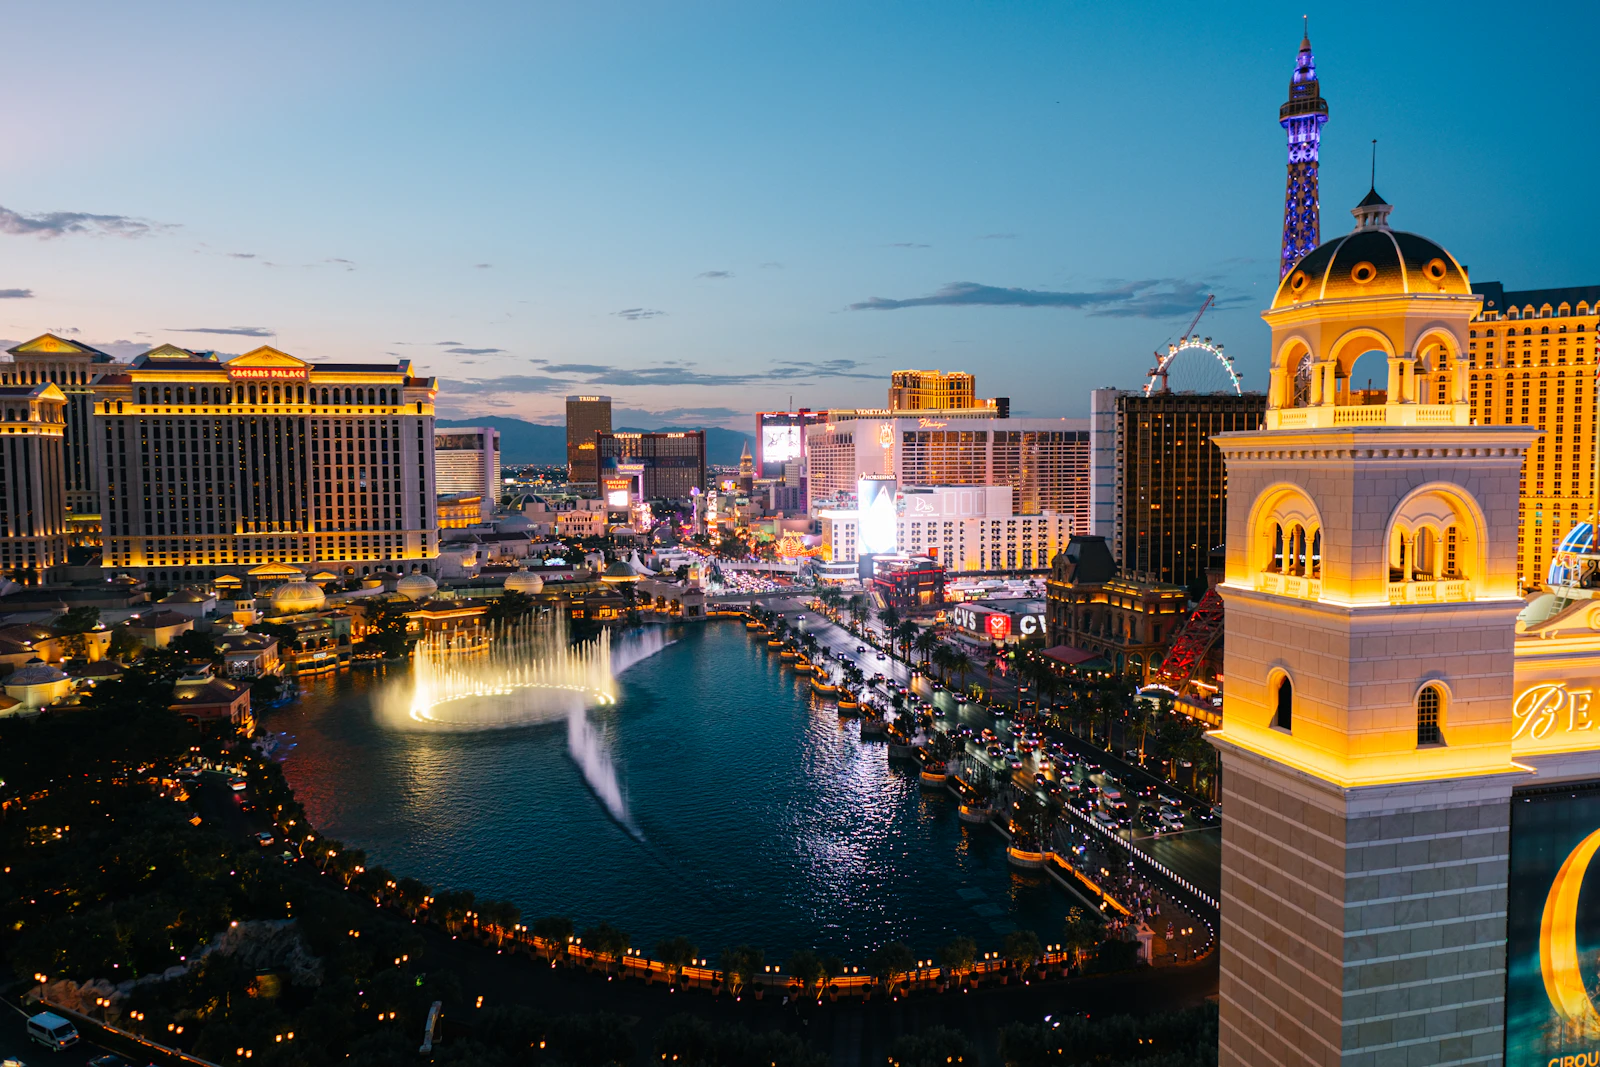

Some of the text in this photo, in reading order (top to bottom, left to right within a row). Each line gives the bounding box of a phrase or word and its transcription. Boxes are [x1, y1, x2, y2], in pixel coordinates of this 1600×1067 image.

[230, 369, 305, 378] CAESARS PALACE
[918, 418, 947, 429] Flamingo
[954, 606, 977, 631] CVS
[1512, 683, 1600, 740] BE
